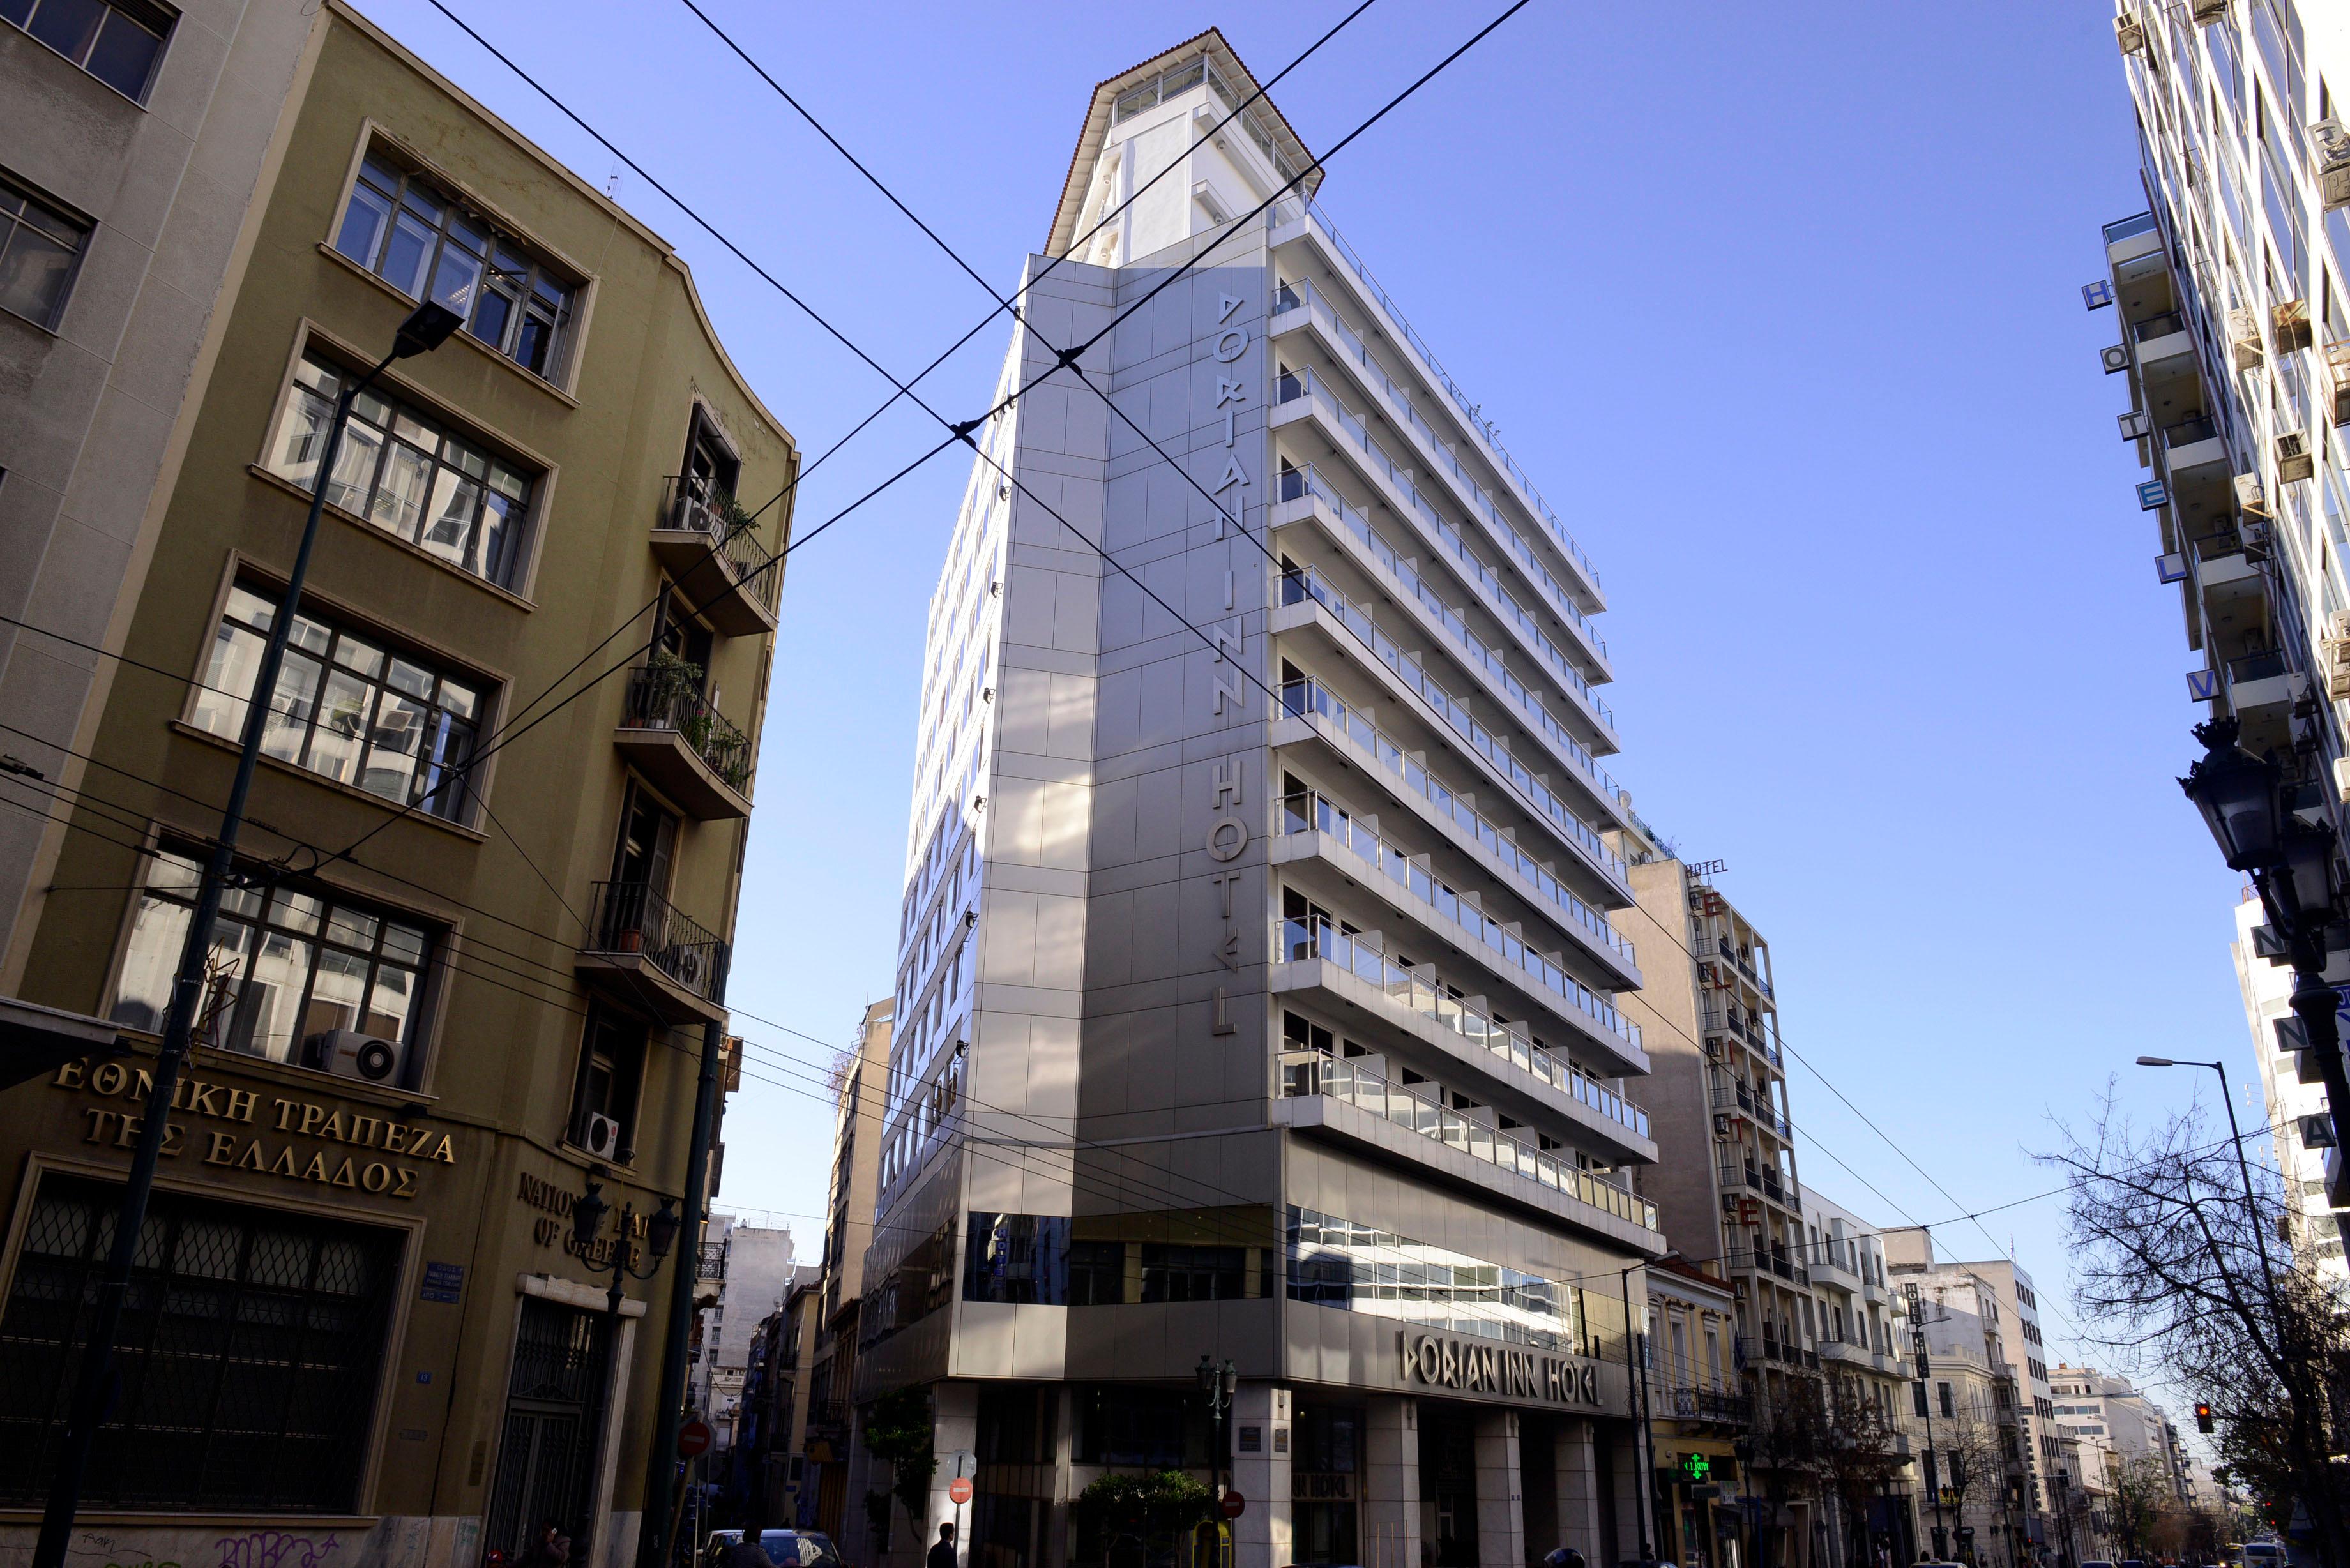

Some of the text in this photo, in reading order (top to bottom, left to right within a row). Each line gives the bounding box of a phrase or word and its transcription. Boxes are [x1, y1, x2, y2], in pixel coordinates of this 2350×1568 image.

[1206, 291, 1250, 1035] DORIAN INN HOTEL
[2084, 282, 2331, 1145] HOTEL VNNA
[1686, 859, 1729, 878] HOTEL
[1703, 892, 1760, 1226] ELITE
[51, 1057, 456, 1165] ΕΘΝΙΚΗ ΤΡΑΠΕΖΑ
[86, 1108, 419, 1198] ΤΗΣ ΕΛΛΑΔΟΣ
[517, 1172, 600, 1225] NATIO
[534, 1216, 641, 1270] OF GEEE
[1907, 1285, 1920, 1323] HOTEL
[420, 1373, 428, 1382] 13
[1397, 1330, 1605, 1406] DORIAN INN HOTEL
